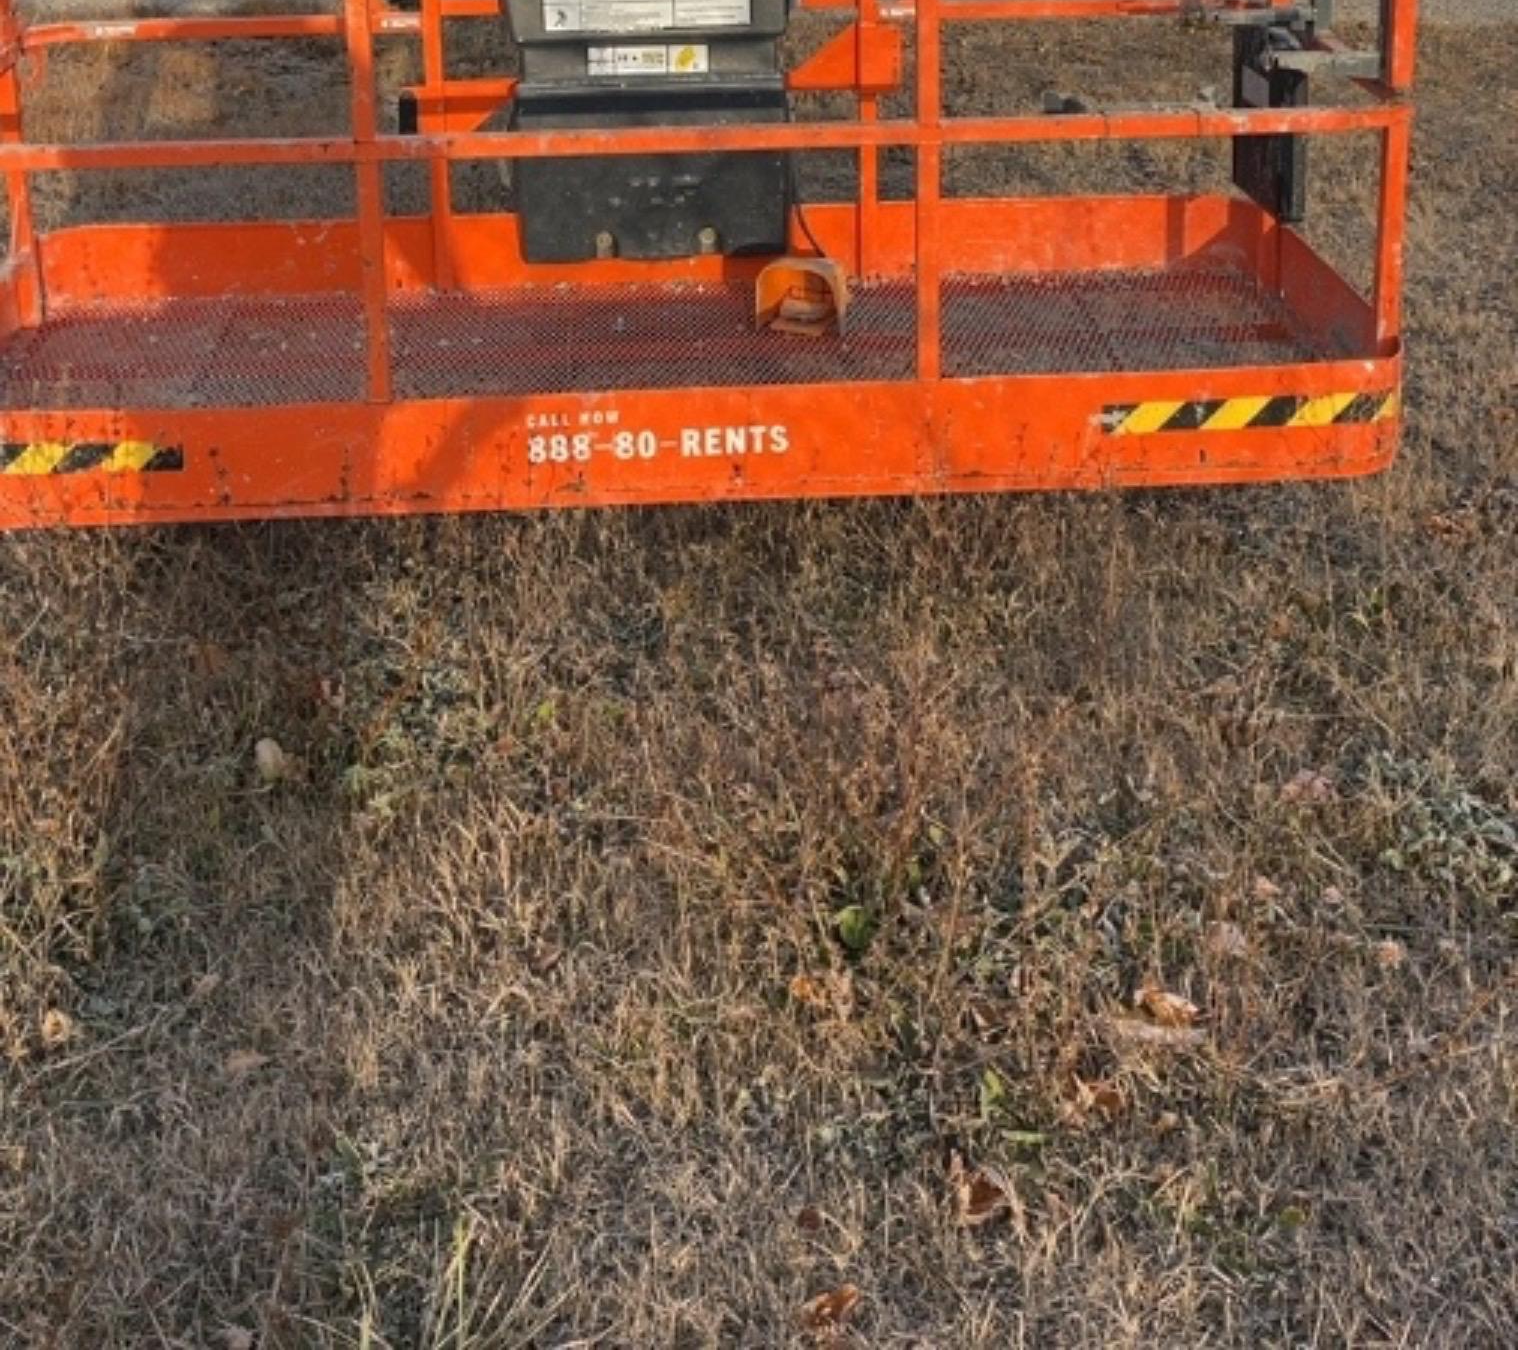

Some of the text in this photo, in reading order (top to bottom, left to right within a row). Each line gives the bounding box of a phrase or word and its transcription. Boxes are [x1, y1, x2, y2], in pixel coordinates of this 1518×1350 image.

[526, 410, 620, 427] CALL NOW
[528, 425, 790, 464] 888-80-RENTS
